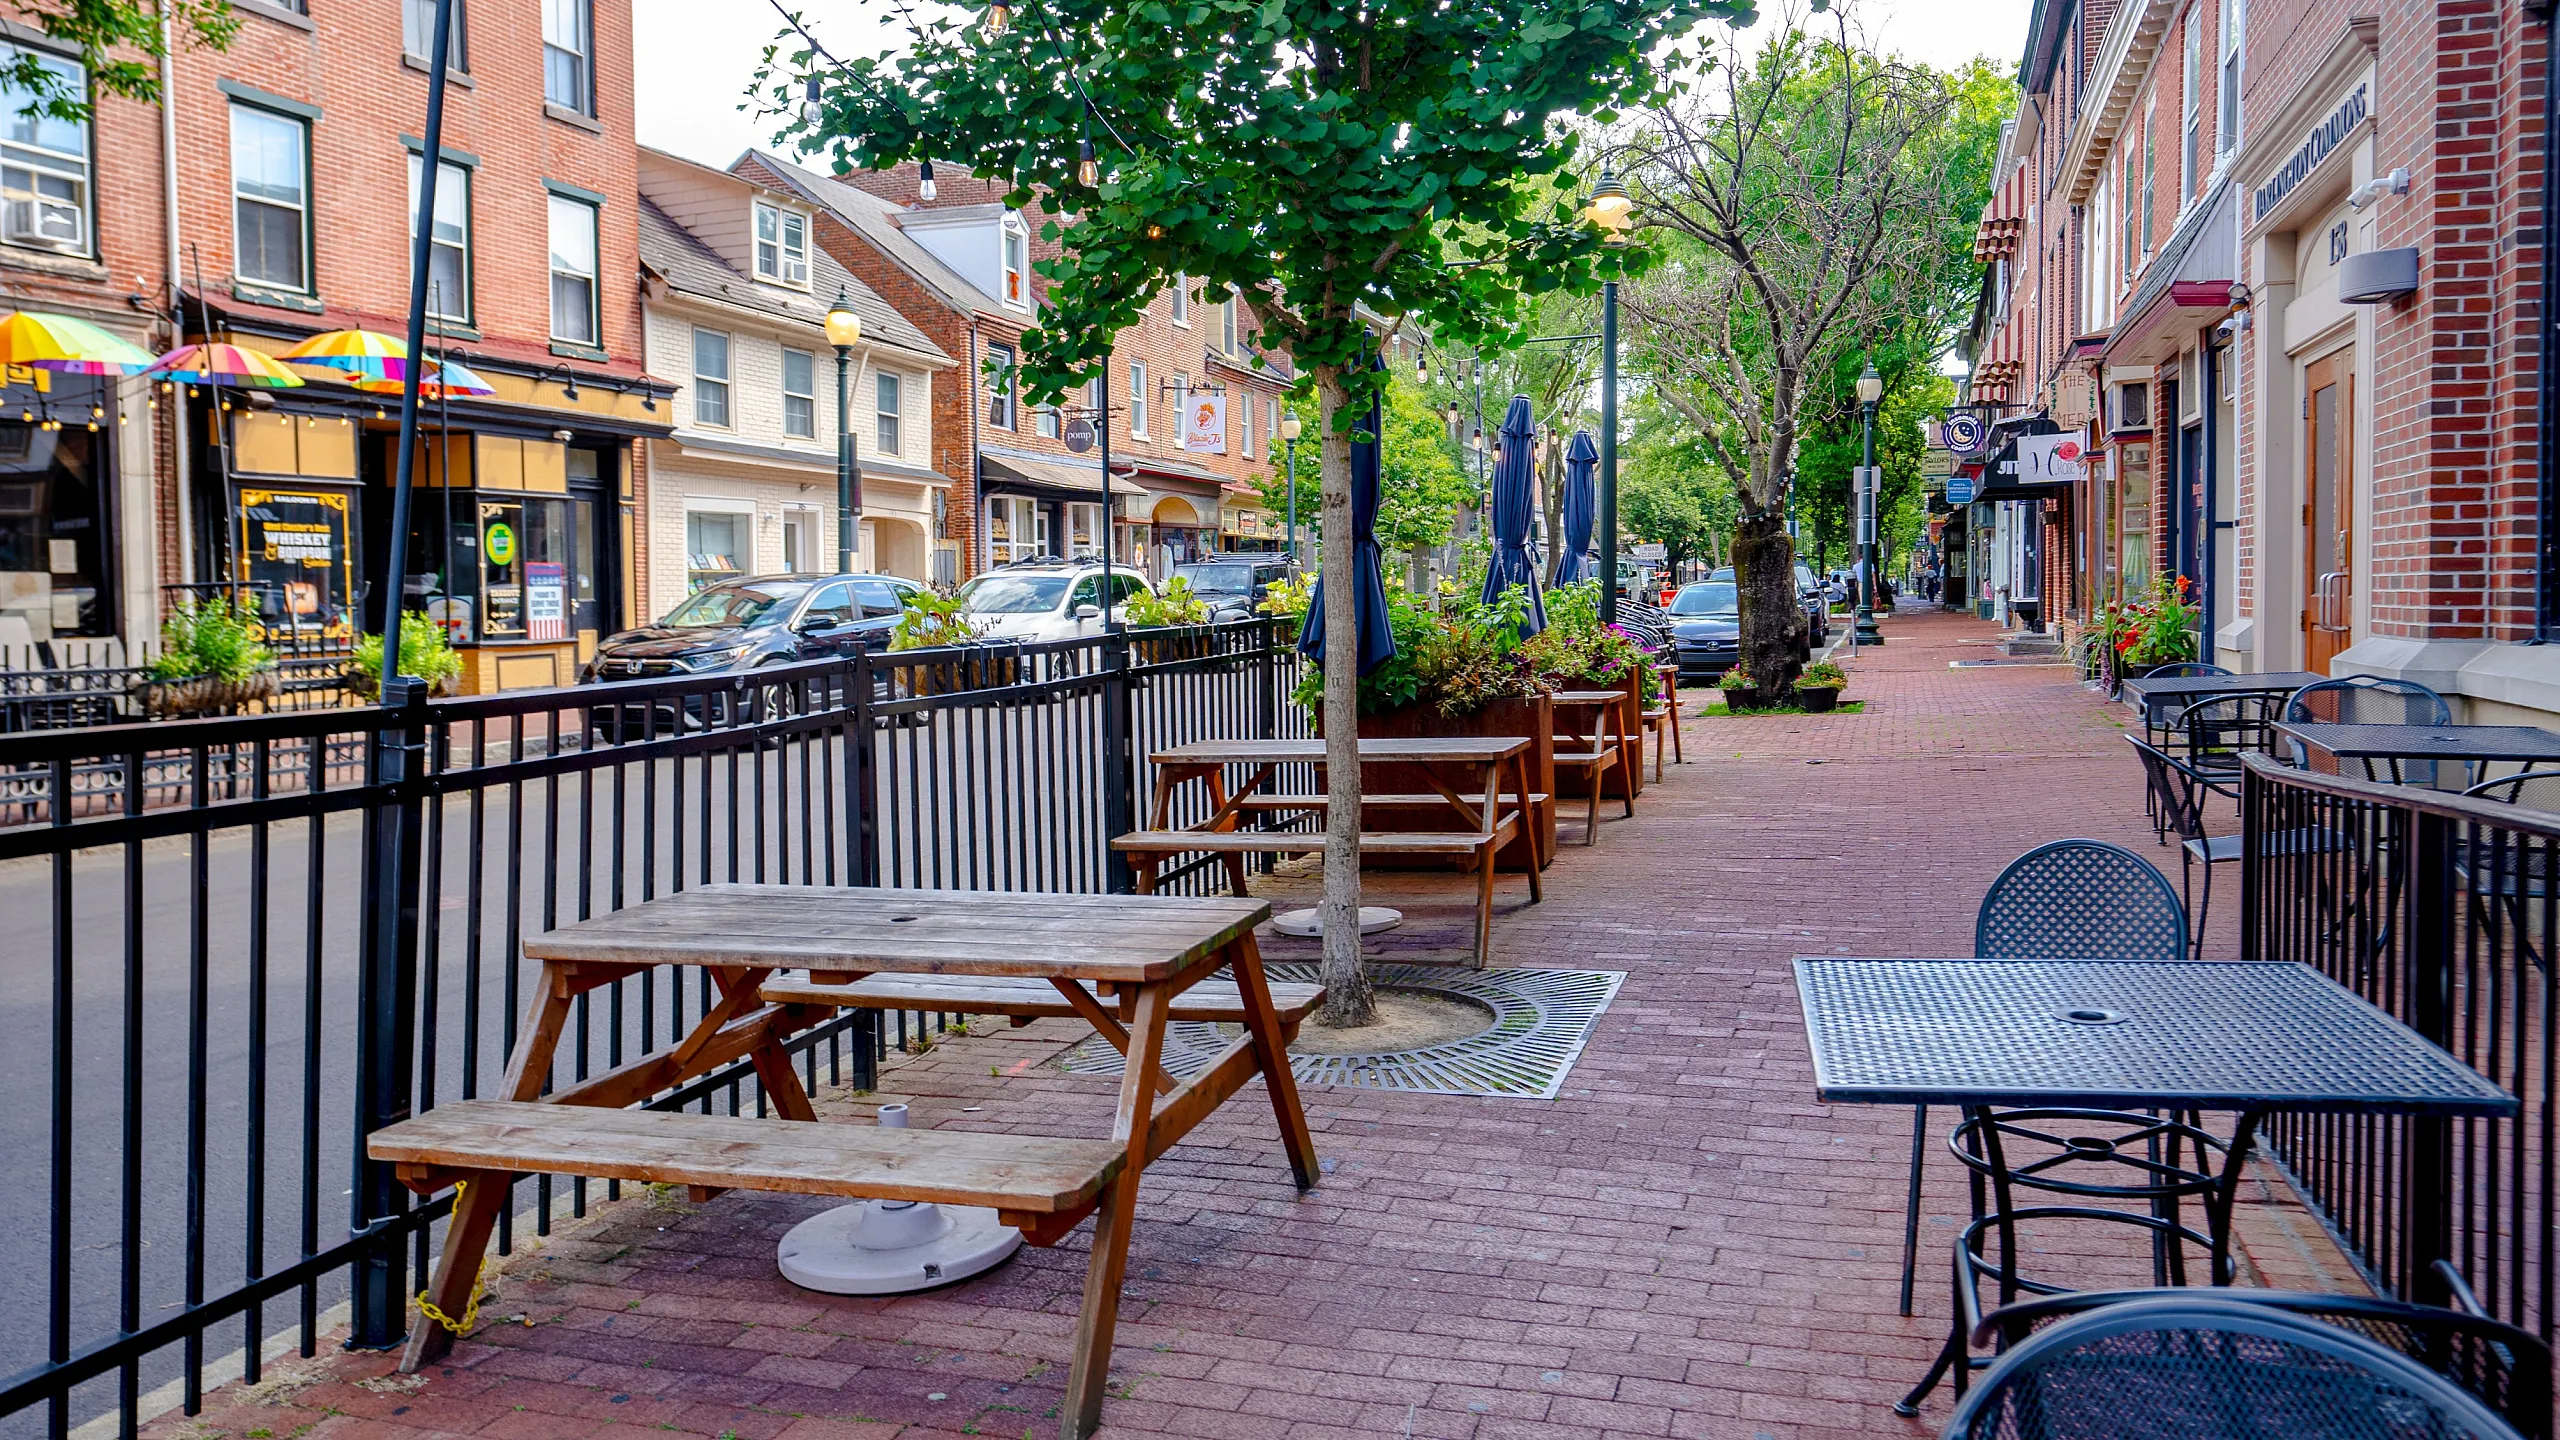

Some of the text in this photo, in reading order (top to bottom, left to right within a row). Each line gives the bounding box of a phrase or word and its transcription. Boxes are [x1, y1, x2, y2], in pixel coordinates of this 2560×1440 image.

[2255, 83, 2367, 222] DARLINGTON COMMONS
[2062, 375, 2085, 389] THE
[1947, 414, 1979, 426] insomnia
[1067, 431, 1092, 441] pomp
[1950, 443, 1975, 452] cookies
[263, 531, 331, 546] WHISKEY
[278, 546, 332, 560] BOURBON
